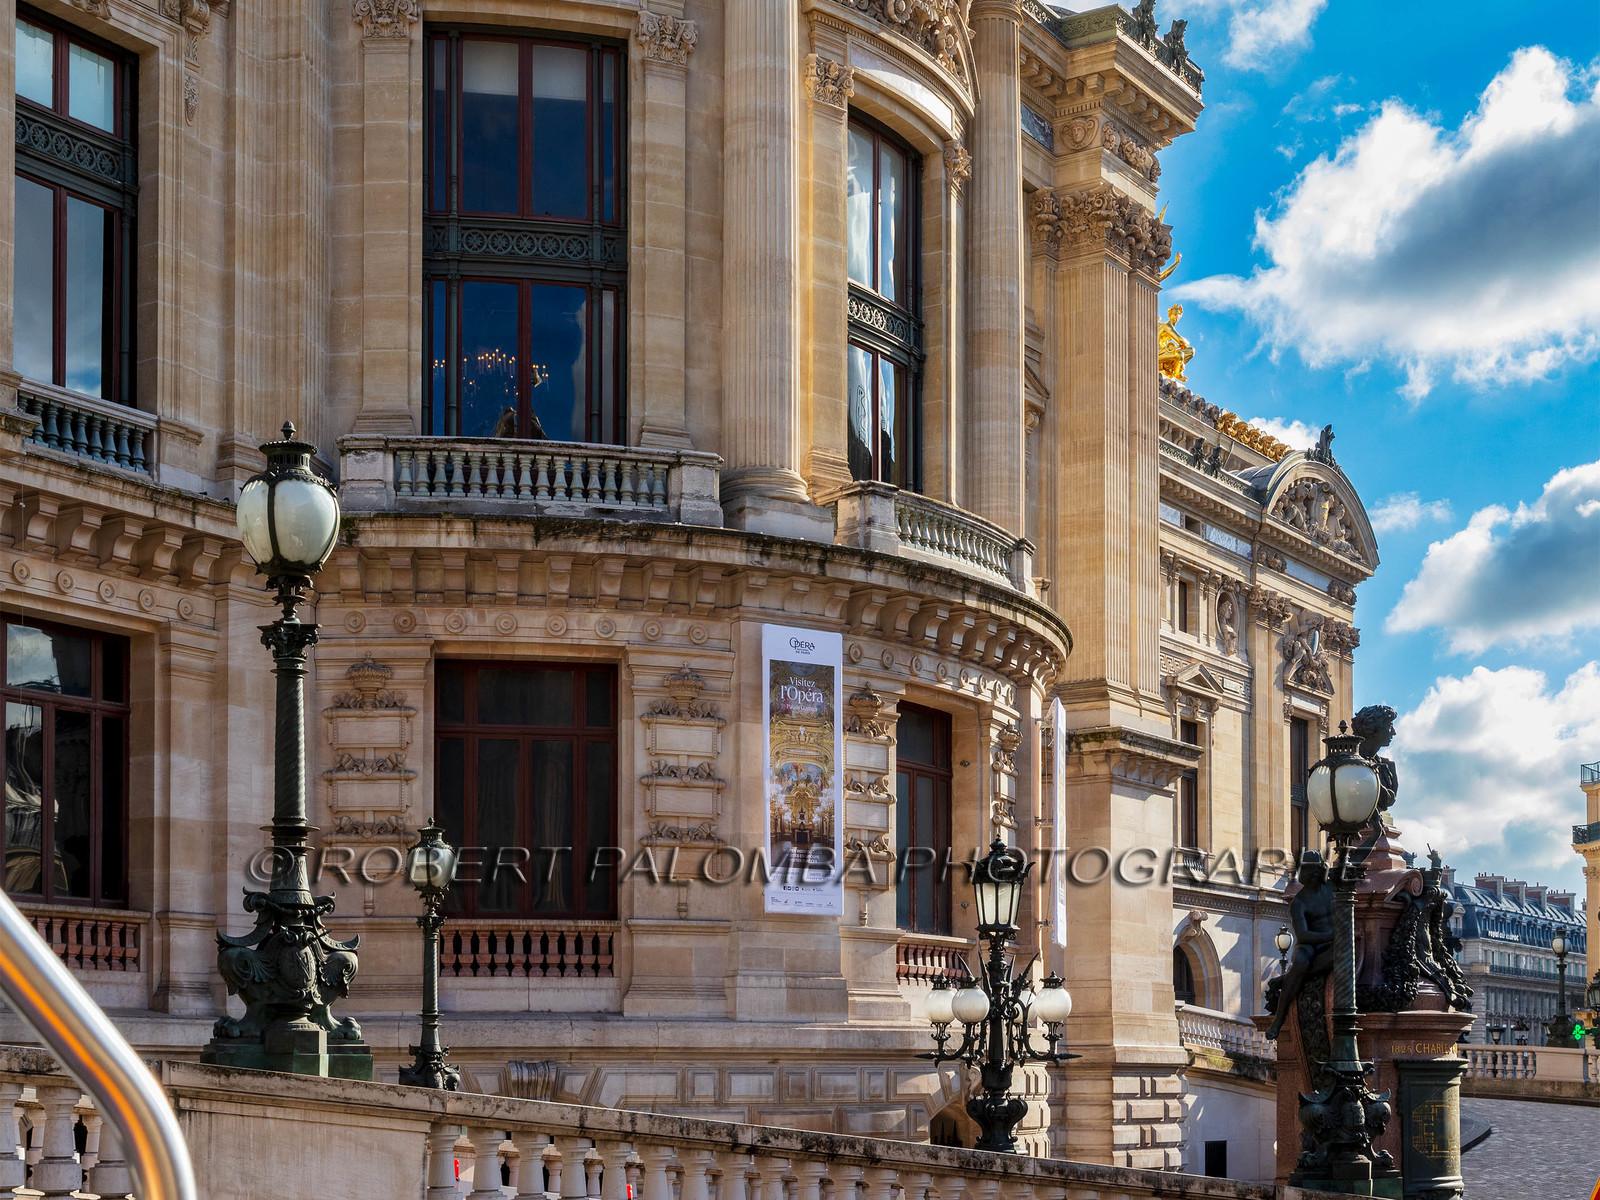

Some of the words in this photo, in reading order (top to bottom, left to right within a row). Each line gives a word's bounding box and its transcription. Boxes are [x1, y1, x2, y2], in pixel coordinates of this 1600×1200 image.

[790, 676, 816, 688] Visitez
[781, 685, 824, 704] l'Opéra
[1415, 1043, 1451, 1054] CHARLES
